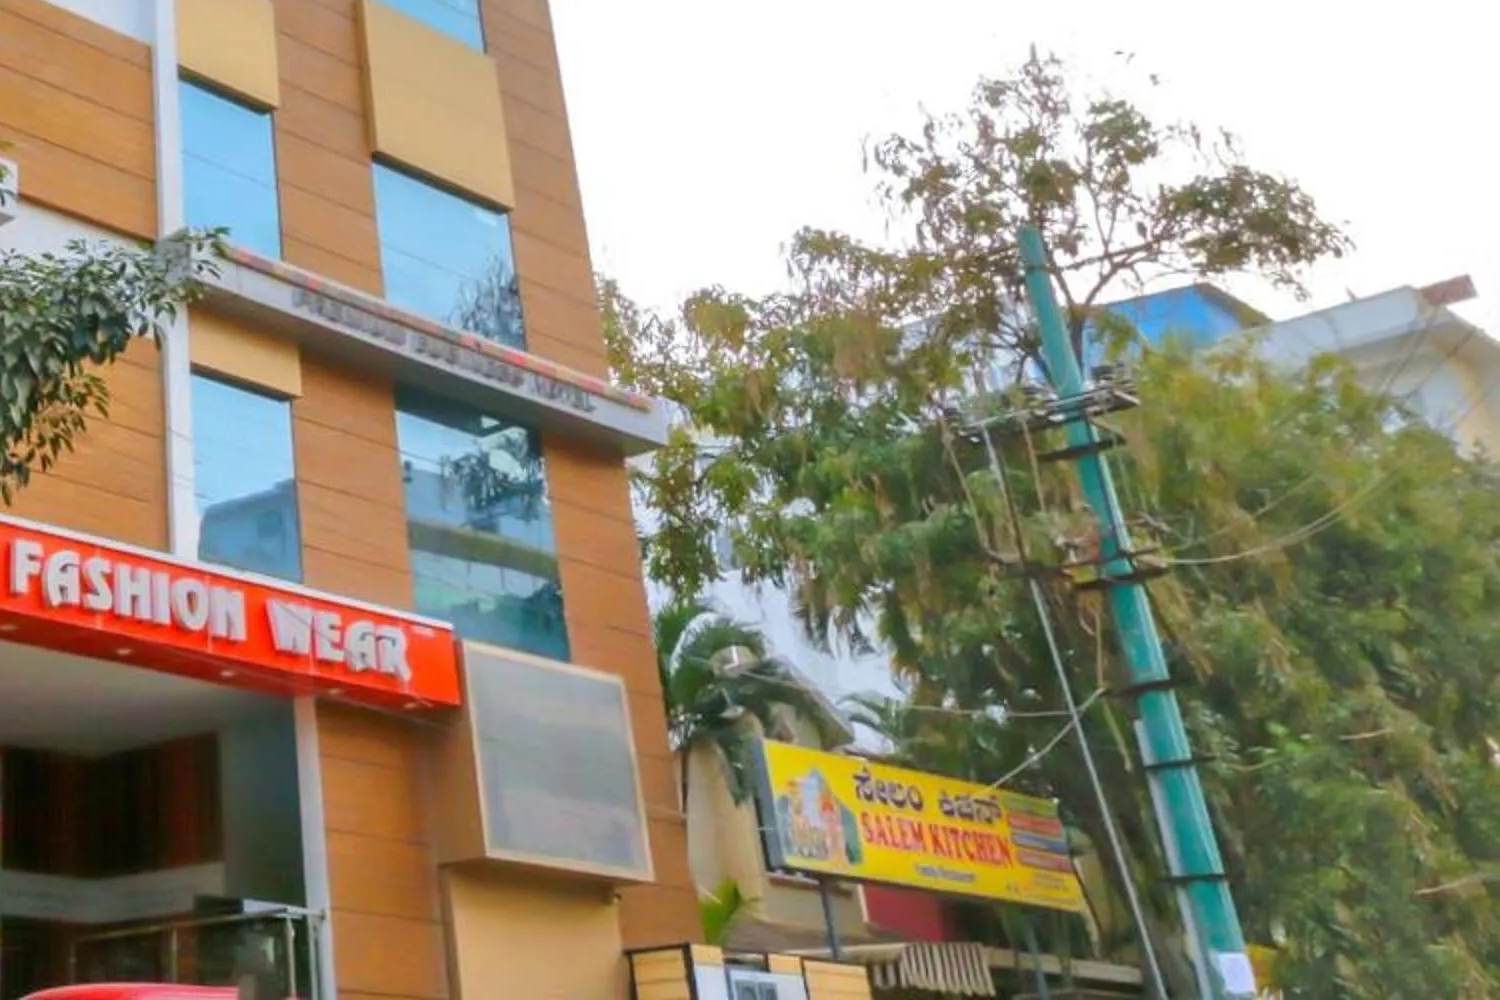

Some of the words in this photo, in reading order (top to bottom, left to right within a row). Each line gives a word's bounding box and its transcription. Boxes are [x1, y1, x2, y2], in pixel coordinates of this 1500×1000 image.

[8, 537, 247, 643] FASHION
[266, 598, 414, 682] WEAR
[861, 810, 927, 854] SALEM
[929, 822, 1014, 868] KITCHEN
